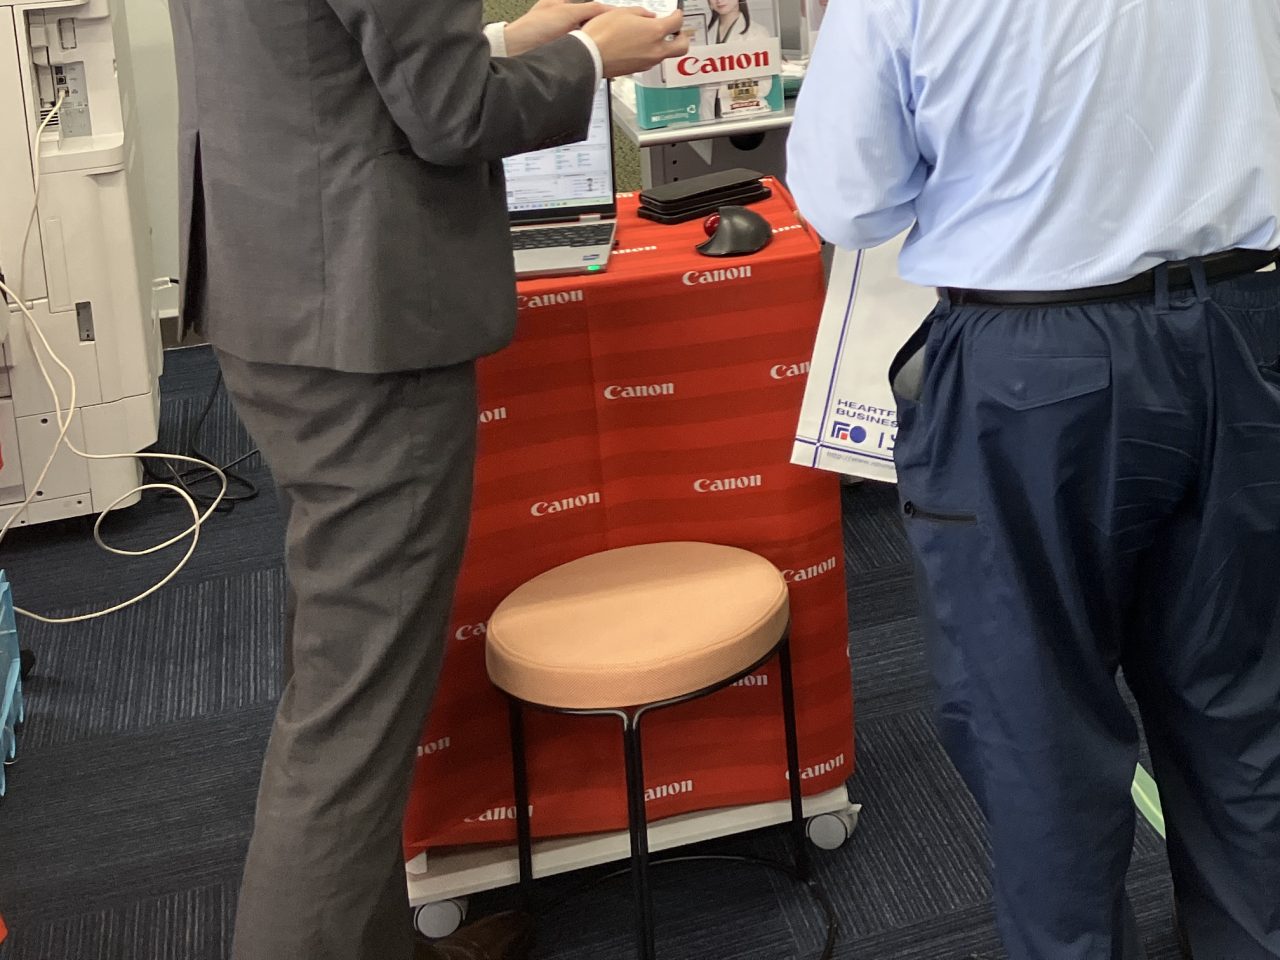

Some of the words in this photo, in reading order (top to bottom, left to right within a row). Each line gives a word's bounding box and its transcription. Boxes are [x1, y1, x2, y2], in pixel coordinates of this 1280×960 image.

[677, 50, 769, 76] Canon
[683, 265, 751, 286] Canon
[770, 360, 811, 380] Can
[603, 382, 675, 400] Canon
[835, 408, 899, 428] BUSINES
[838, 399, 896, 417] HEARTF
[693, 473, 762, 493] Canon
[530, 491, 601, 517] Canon
[644, 779, 694, 802] anon
